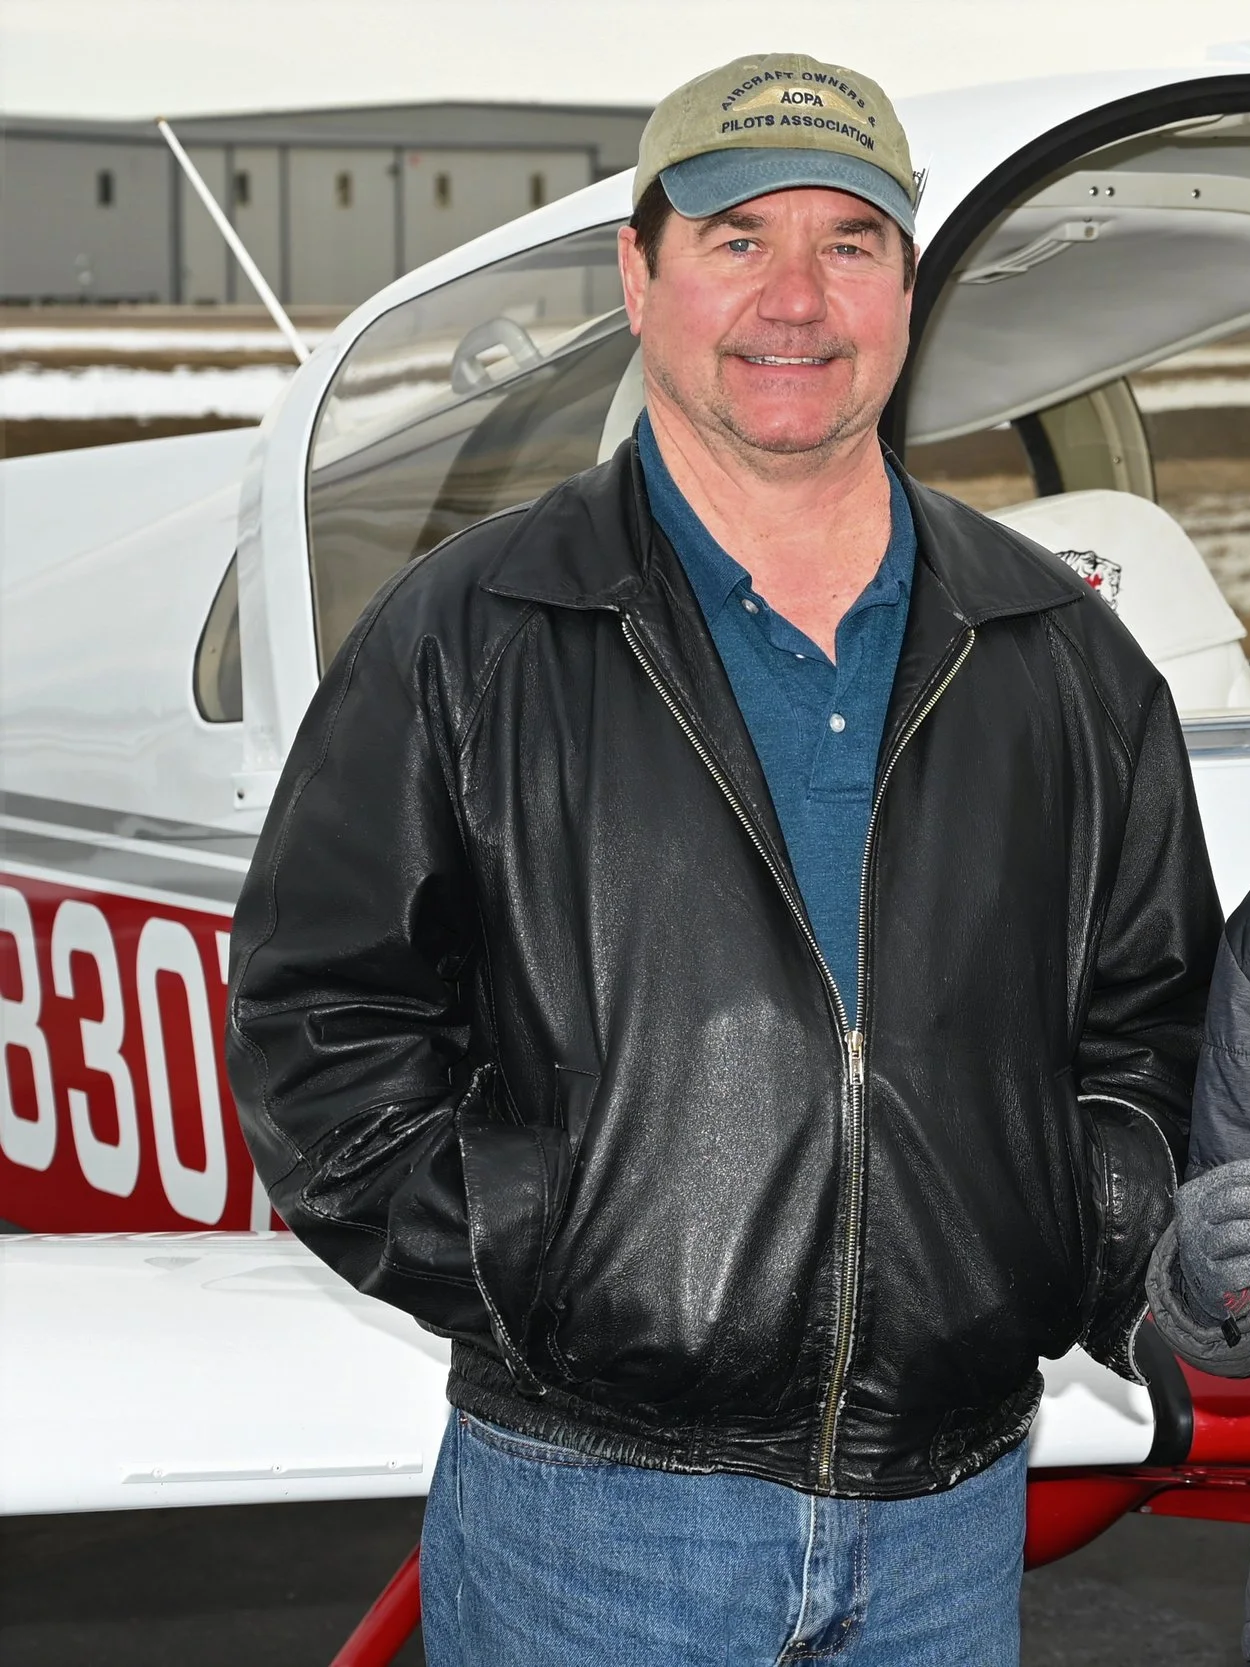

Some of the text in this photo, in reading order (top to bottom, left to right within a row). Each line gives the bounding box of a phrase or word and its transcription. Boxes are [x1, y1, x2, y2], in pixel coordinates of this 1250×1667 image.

[722, 70, 876, 128] AIRCRAFT OWNERS &
[780, 91, 824, 107] AOPA
[721, 114, 874, 151] PILOTS ASSOCIATION
